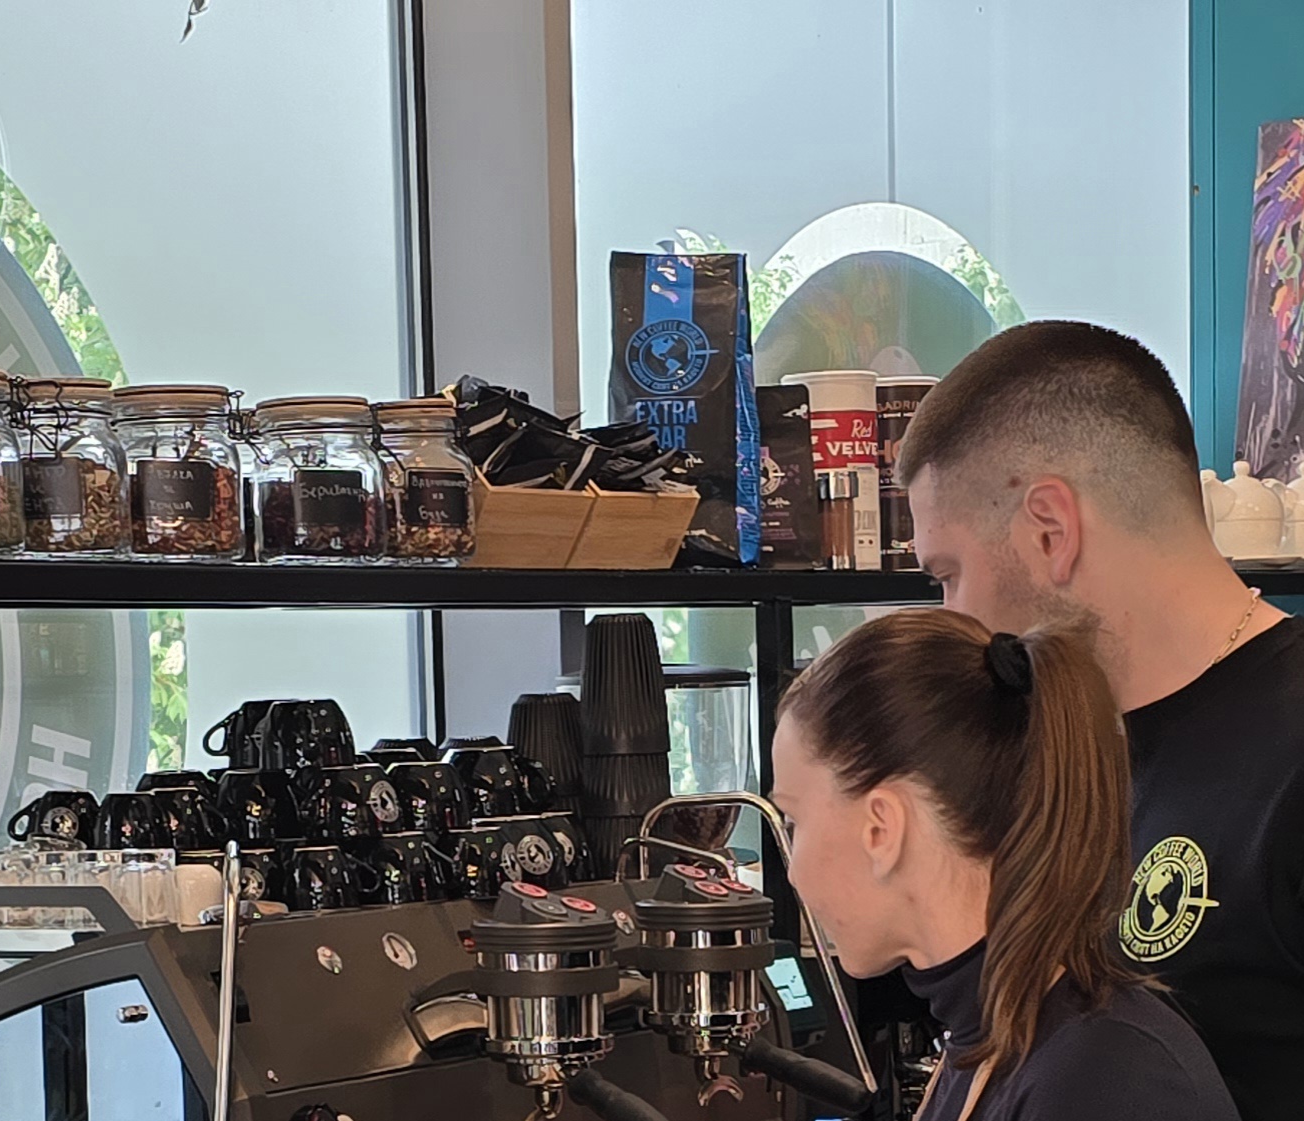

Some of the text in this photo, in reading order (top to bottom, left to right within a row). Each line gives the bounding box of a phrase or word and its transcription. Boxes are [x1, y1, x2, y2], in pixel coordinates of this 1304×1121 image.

[635, 399, 699, 425] EXTRA
[851, 418, 873, 439] Red
[826, 440, 879, 458] VELVE
